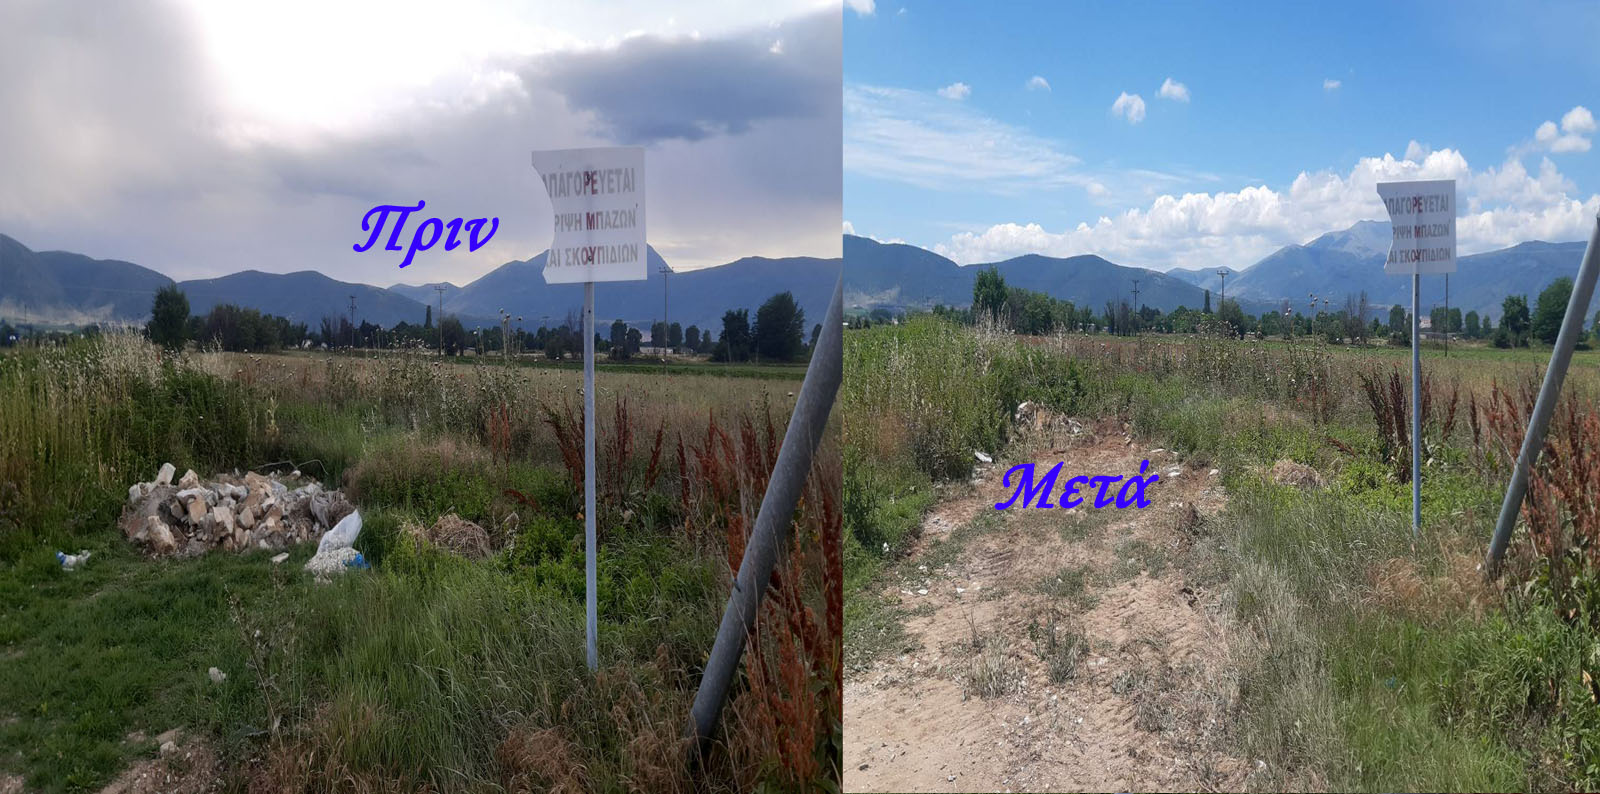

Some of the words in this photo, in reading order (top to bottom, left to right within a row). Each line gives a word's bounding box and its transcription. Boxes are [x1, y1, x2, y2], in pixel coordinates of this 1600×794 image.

[554, 212, 582, 232] ΡΙΨΗ
[586, 208, 636, 230] ΜΠΑΖΩΝ
[1392, 224, 1412, 240] ΡΙΨΗ
[1414, 223, 1450, 239] ΜΠΑΖΩΝ
[546, 248, 561, 268] ΑΙ
[565, 244, 639, 267] ΣΚΟΥΠΙΔΙΩΝ
[1387, 249, 1397, 264] ΑΙ
[1399, 247, 1451, 264] ΣΚΟΥΠΙΔΙΩΝ
